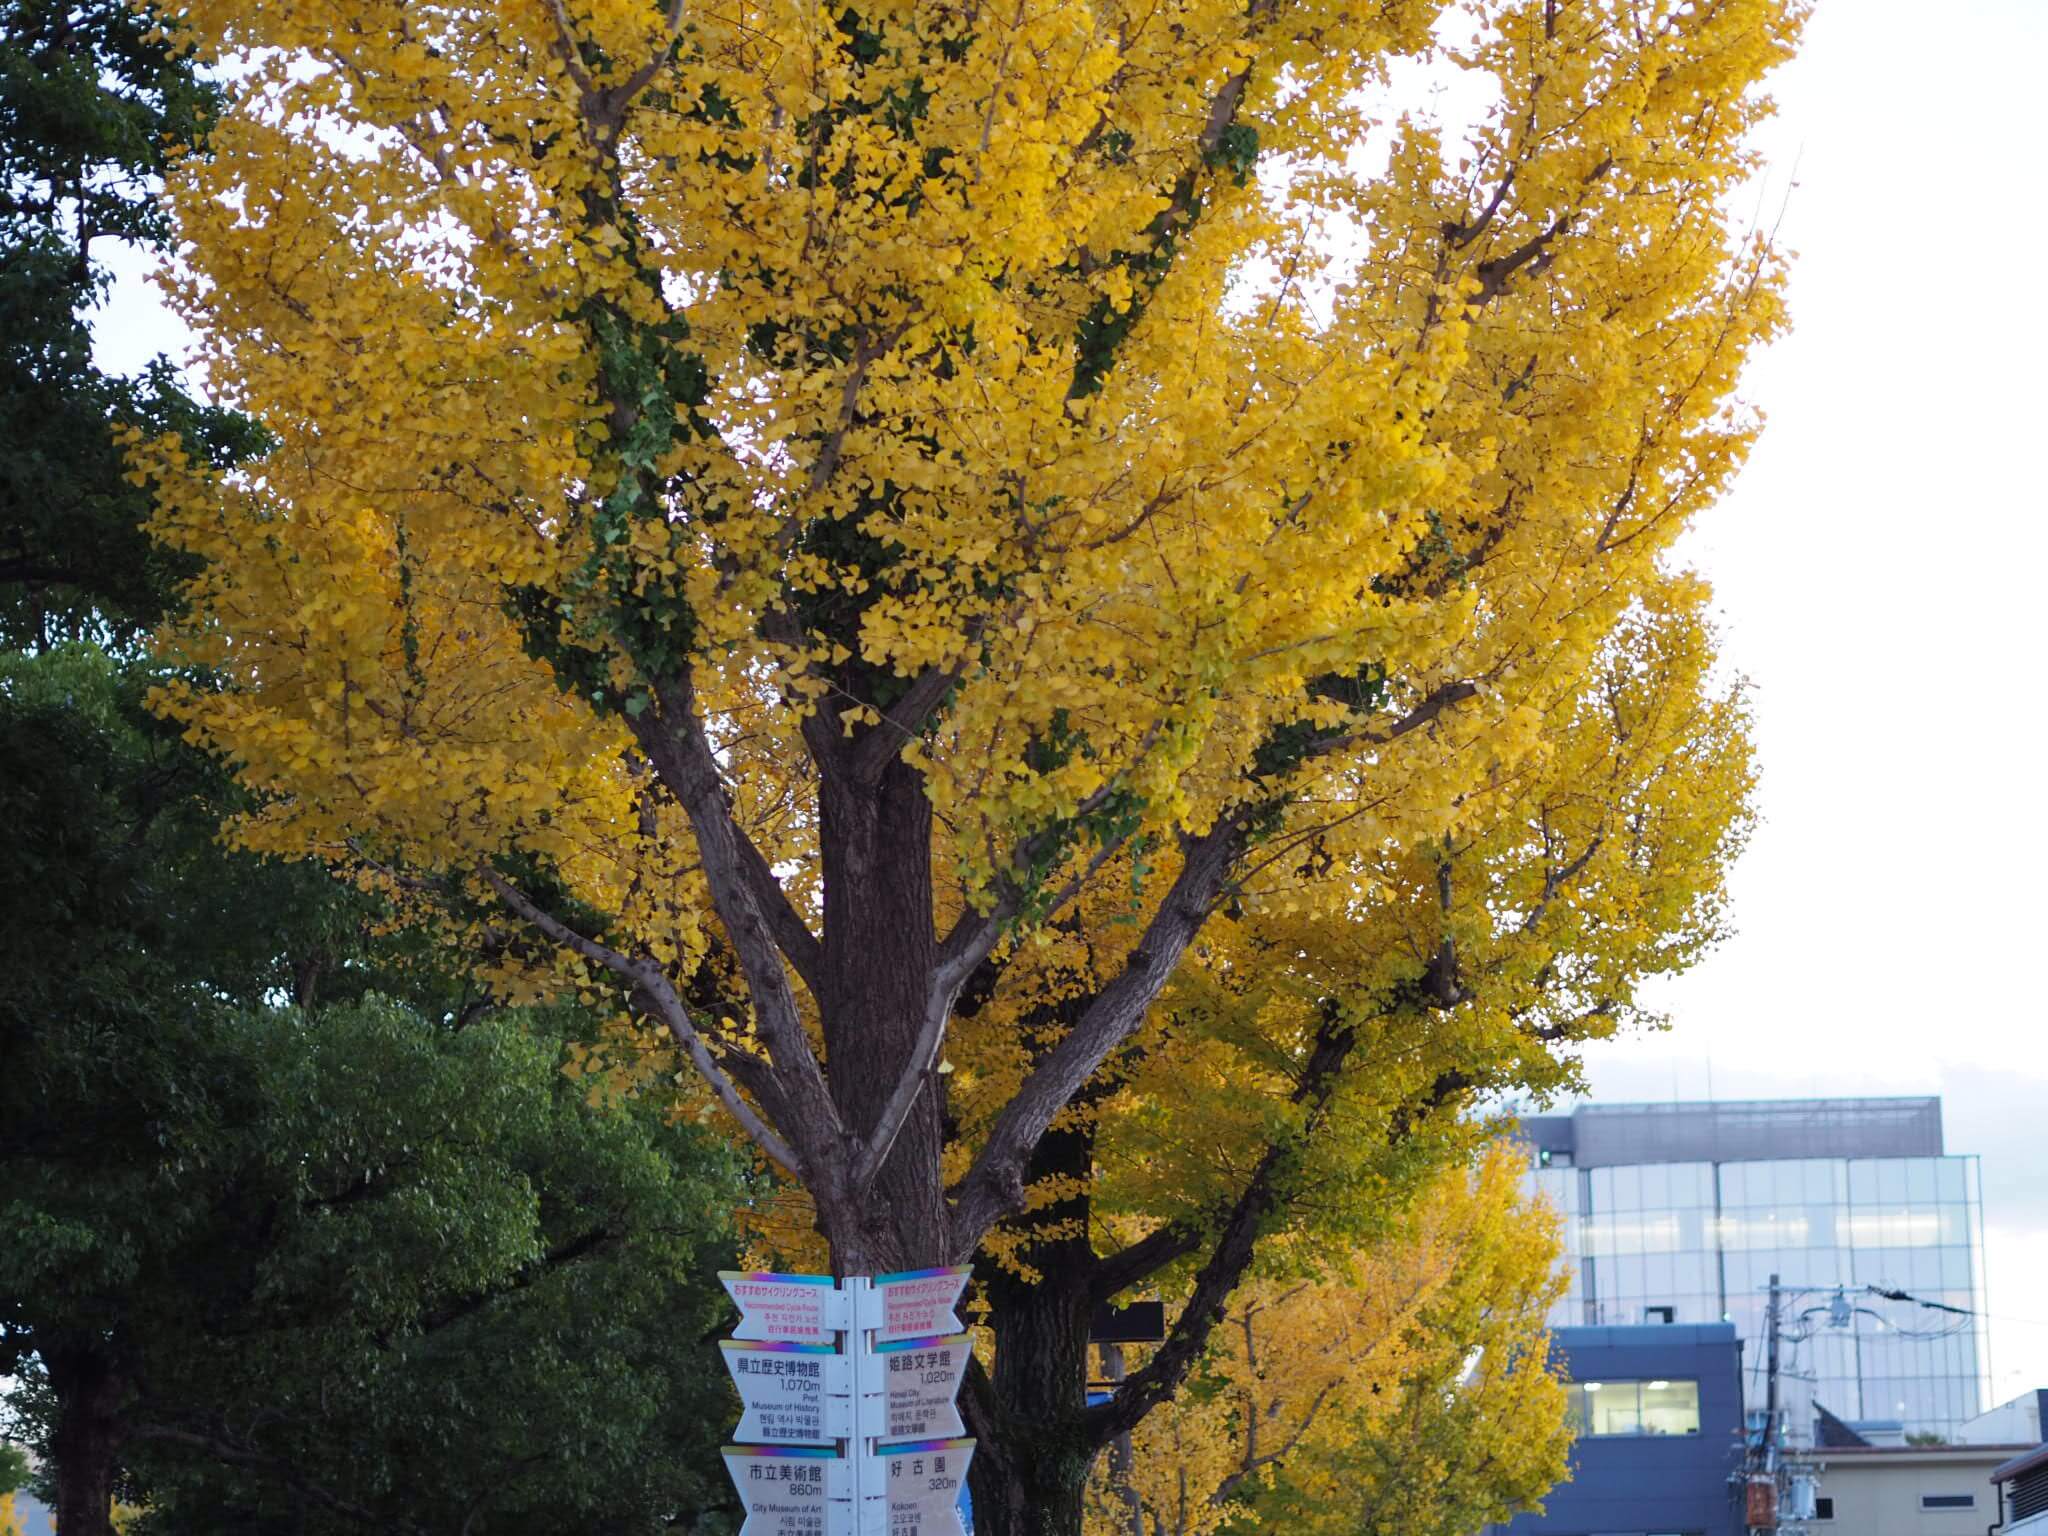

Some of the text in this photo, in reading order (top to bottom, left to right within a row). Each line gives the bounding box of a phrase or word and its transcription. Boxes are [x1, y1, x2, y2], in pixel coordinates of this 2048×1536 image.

[737, 1357, 820, 1377] 県立歴史博物館
[752, 1401, 820, 1413] Museum of History
[750, 1464, 822, 1481] 市立美術館
[789, 1483, 822, 1496] 860m
[928, 1477, 957, 1490] 320m
[752, 1503, 822, 1513] City Museum of Art
